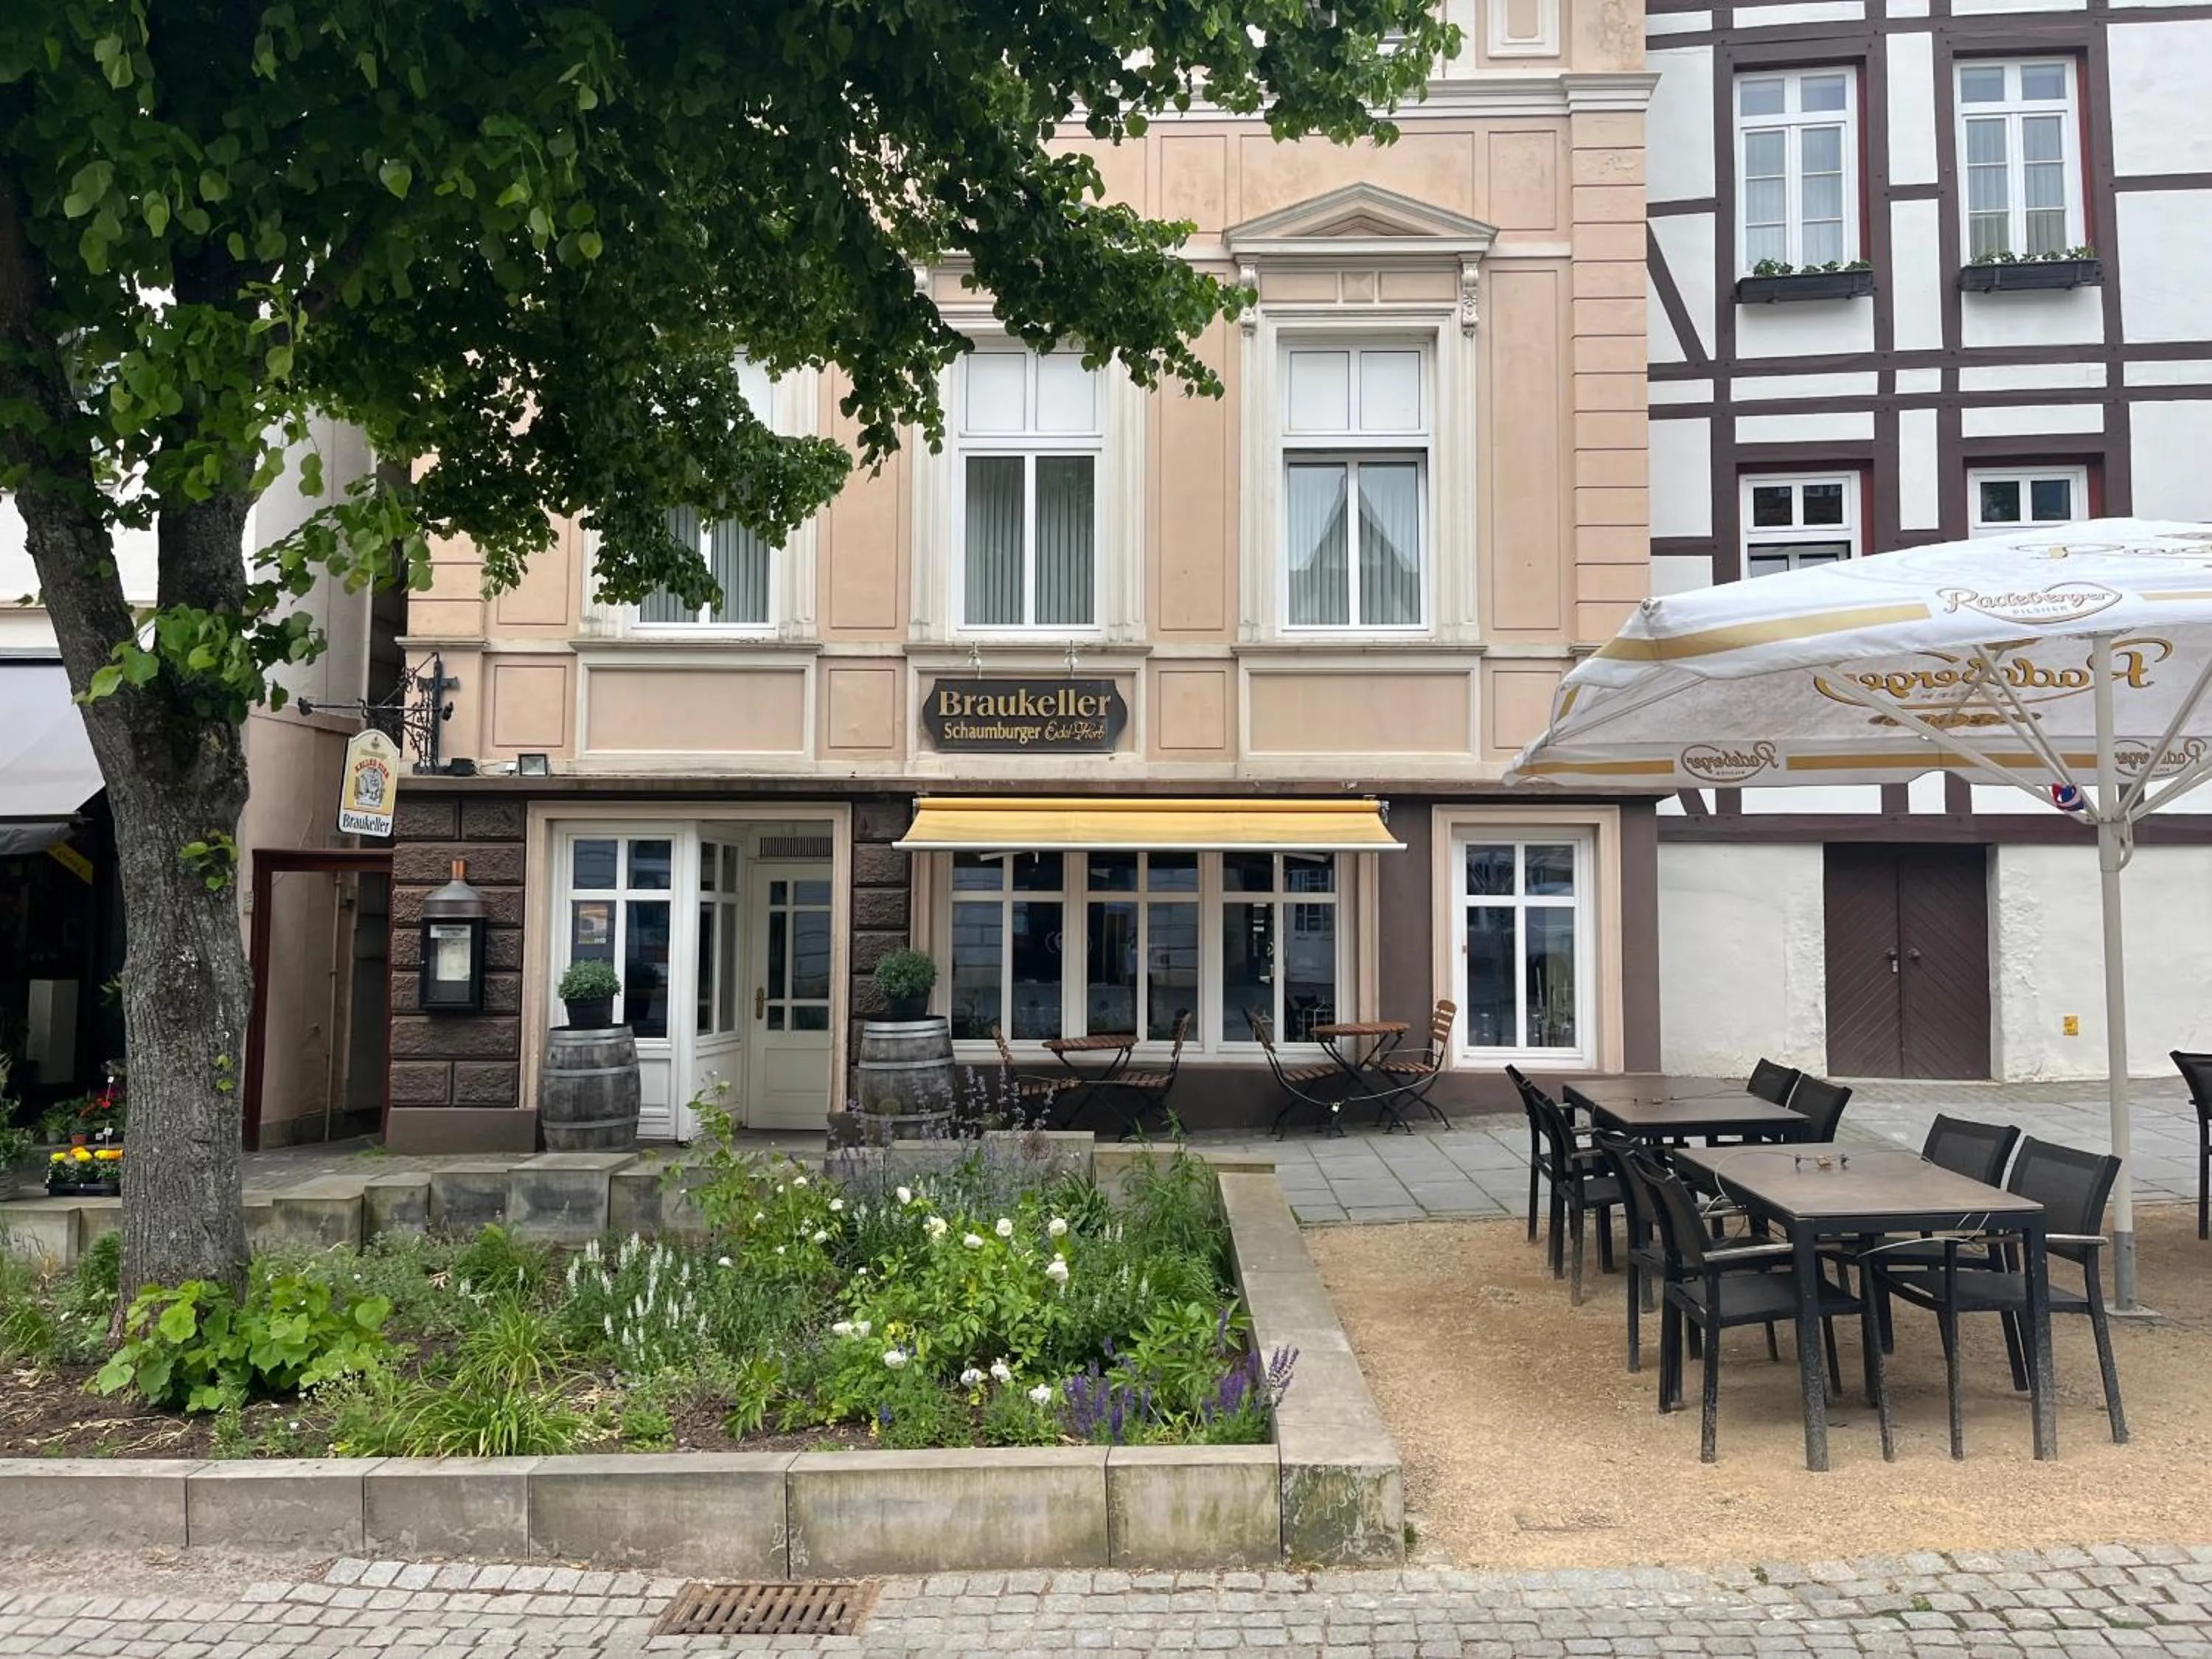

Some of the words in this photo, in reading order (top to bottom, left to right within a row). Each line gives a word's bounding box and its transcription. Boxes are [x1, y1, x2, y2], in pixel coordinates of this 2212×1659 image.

[1936, 587, 2112, 613] Radeberger
[938, 689, 1111, 717] Braukeller
[944, 722, 1042, 744] Schaumburger
[342, 813, 390, 833] Braukeller
